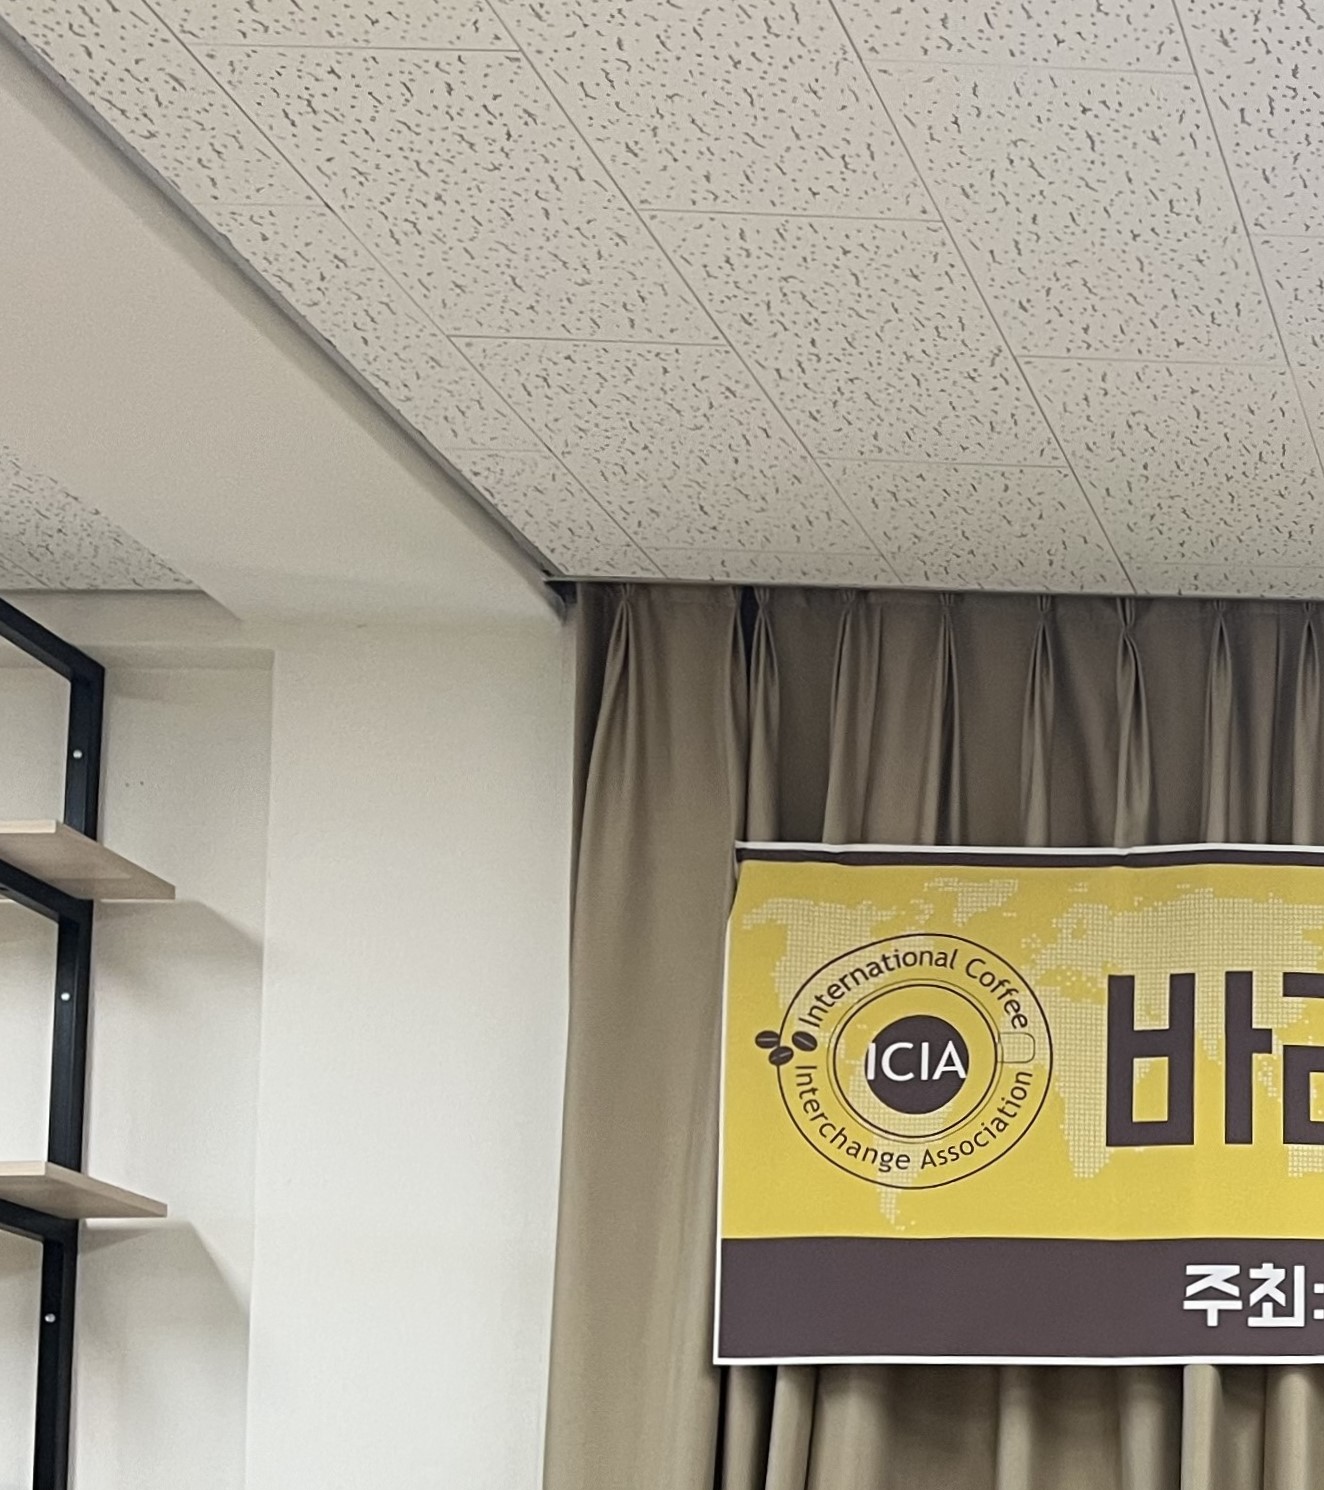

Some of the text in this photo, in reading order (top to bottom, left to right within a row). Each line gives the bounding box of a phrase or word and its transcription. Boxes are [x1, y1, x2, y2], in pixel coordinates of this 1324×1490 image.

[798, 949, 1028, 1029] International Coffee
[866, 1040, 967, 1081] ICIA
[795, 1065, 1033, 1172] Interchange Association
